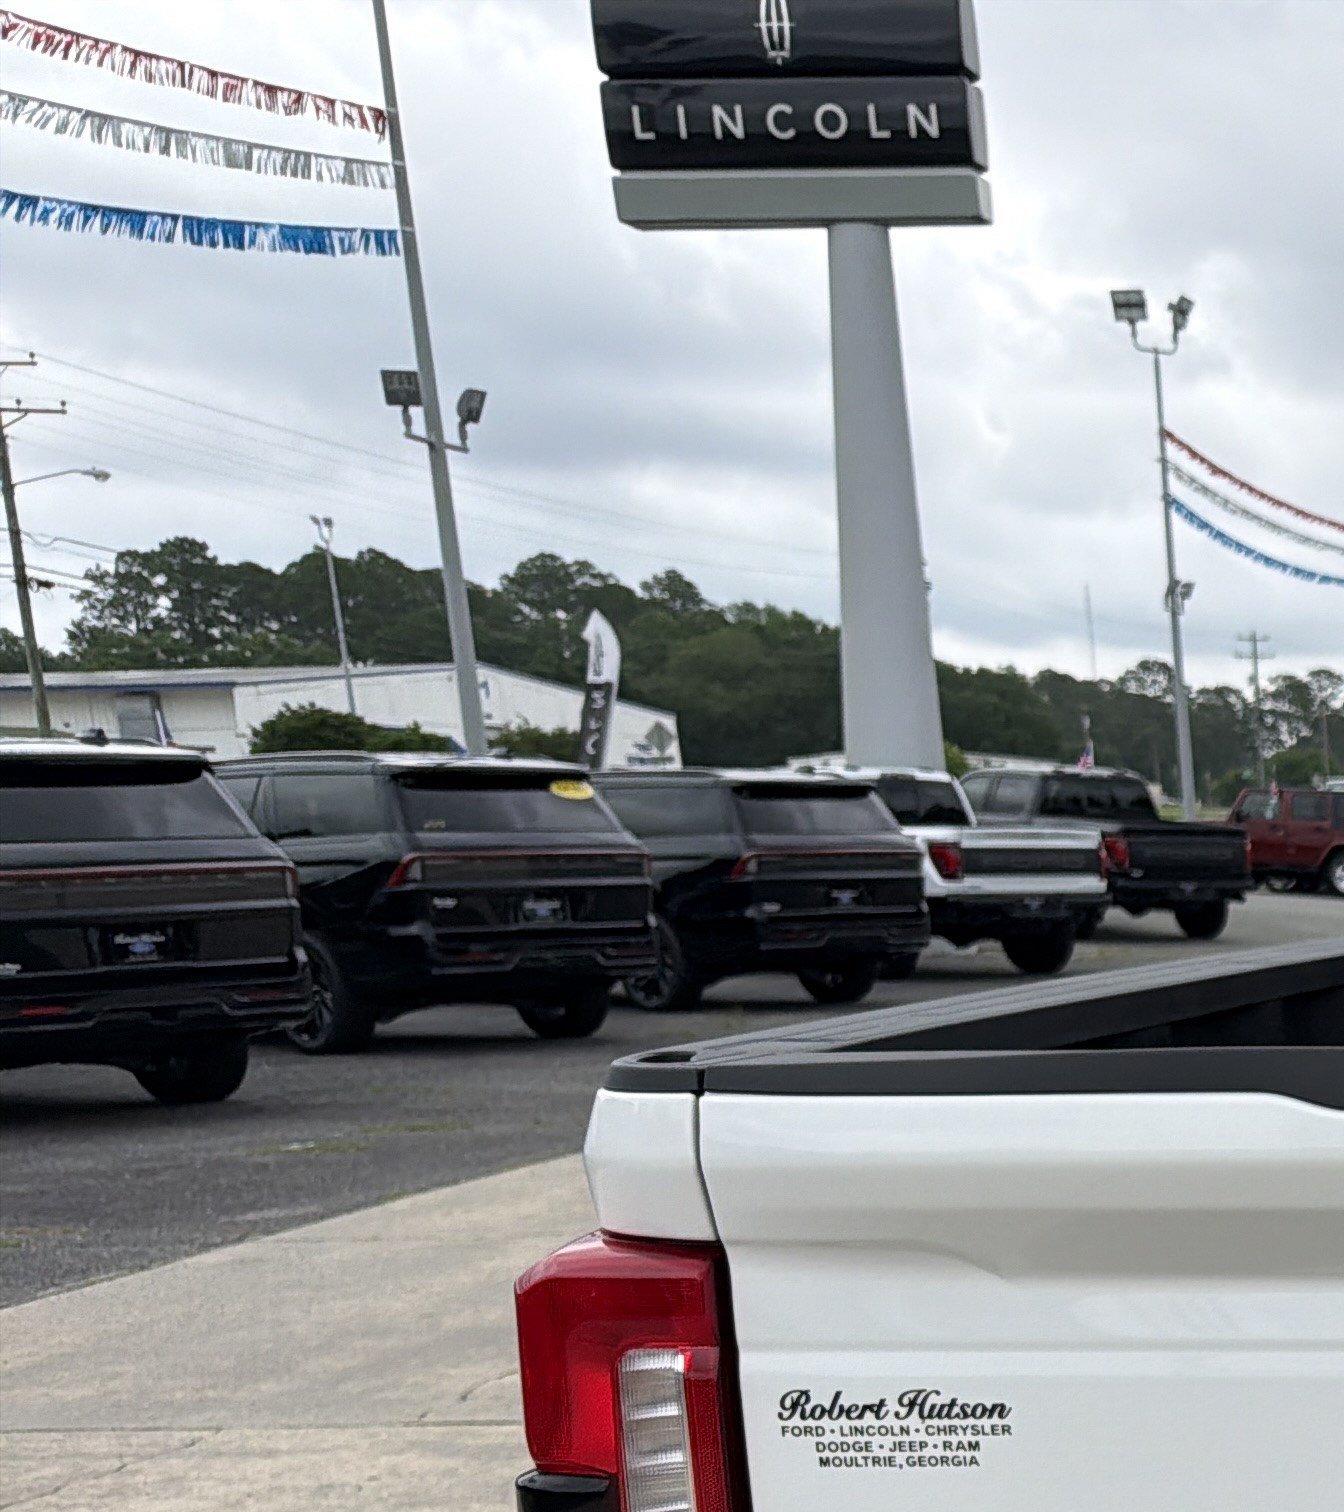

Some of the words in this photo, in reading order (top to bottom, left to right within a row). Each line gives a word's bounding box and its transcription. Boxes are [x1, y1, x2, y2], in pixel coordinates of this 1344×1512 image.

[631, 103, 941, 141] LINCOLN
[777, 1389, 890, 1422] Robert
[893, 1388, 1013, 1423] Hutson
[780, 1425, 827, 1438] FORD
[839, 1425, 912, 1437] LINCOLN
[924, 1424, 1013, 1437] CHRYSLER
[815, 1440, 875, 1453] DODGE
[888, 1440, 929, 1453] JEEP
[942, 1440, 982, 1453] RAM
[818, 1456, 904, 1470] MOULTRIE,
[905, 1455, 981, 1469] GEORGIA
